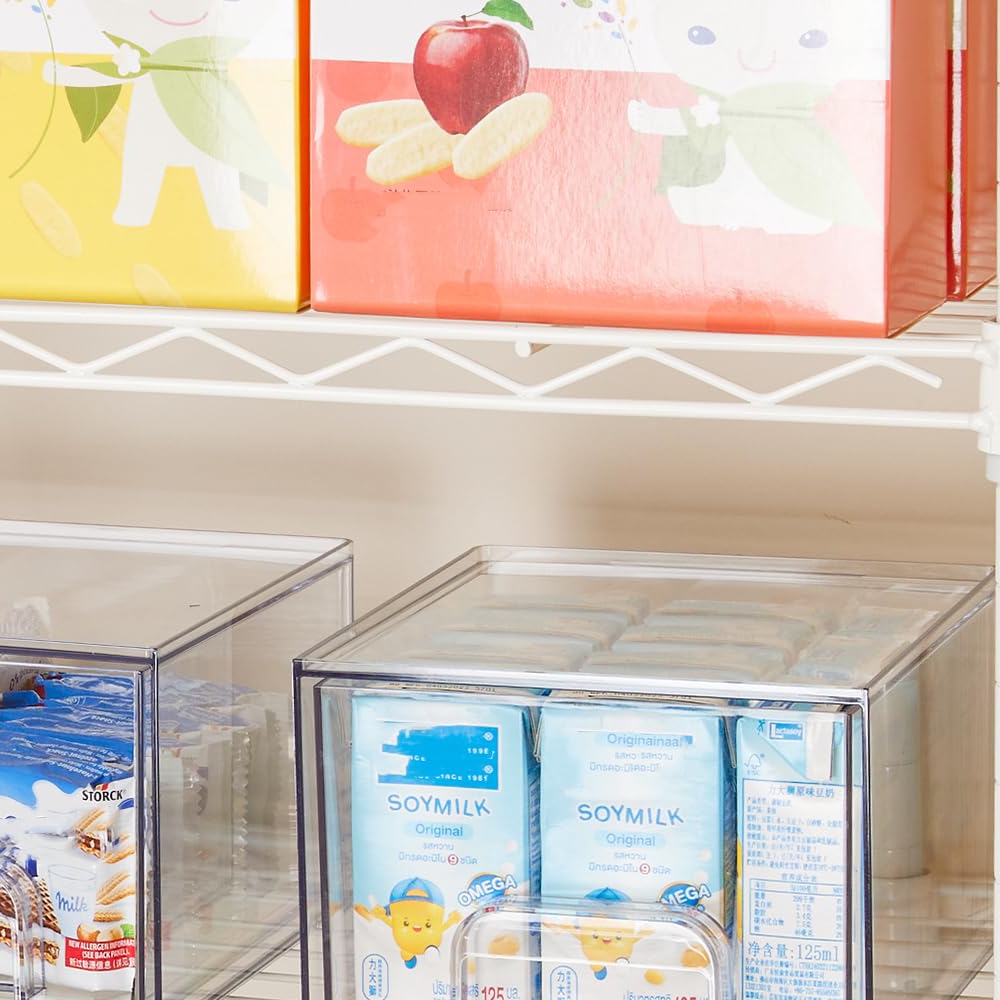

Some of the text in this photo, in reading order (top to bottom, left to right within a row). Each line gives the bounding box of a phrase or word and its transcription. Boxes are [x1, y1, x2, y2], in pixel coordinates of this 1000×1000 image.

[82, 789, 123, 802] STORCK
[387, 794, 490, 817] SOYMILK
[577, 803, 684, 826] SOYMILK
[415, 823, 463, 838] Original
[606, 833, 656, 848] Original
[458, 873, 519, 907] OMEGA
[660, 883, 712, 907] MEGA
[79, 940, 109, 951] ALLERGEN
